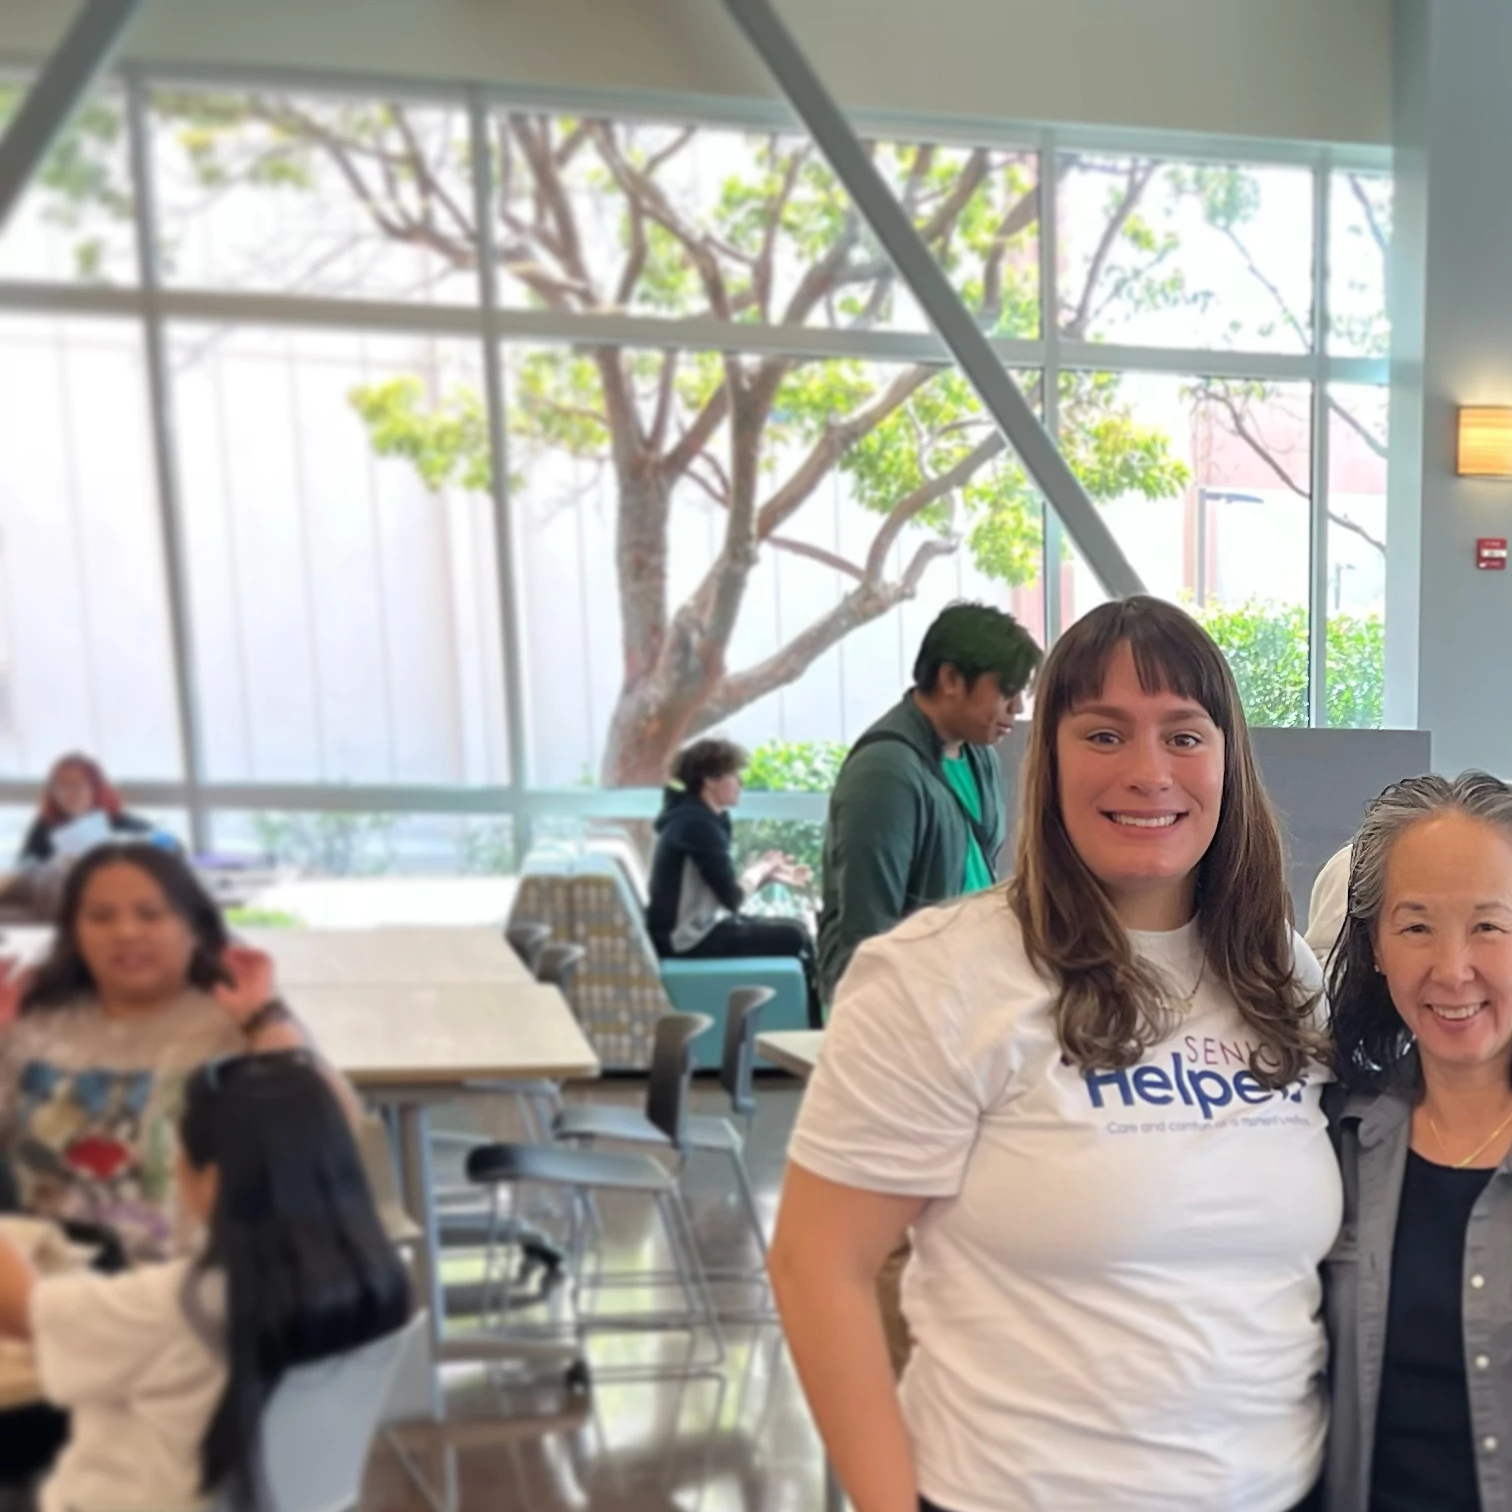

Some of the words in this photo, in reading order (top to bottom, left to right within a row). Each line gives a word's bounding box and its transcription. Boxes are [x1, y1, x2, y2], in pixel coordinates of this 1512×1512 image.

[1184, 1035, 1276, 1067] SENI
[1085, 1052, 1309, 1120] Helpe
[1141, 1119, 1166, 1133] and
